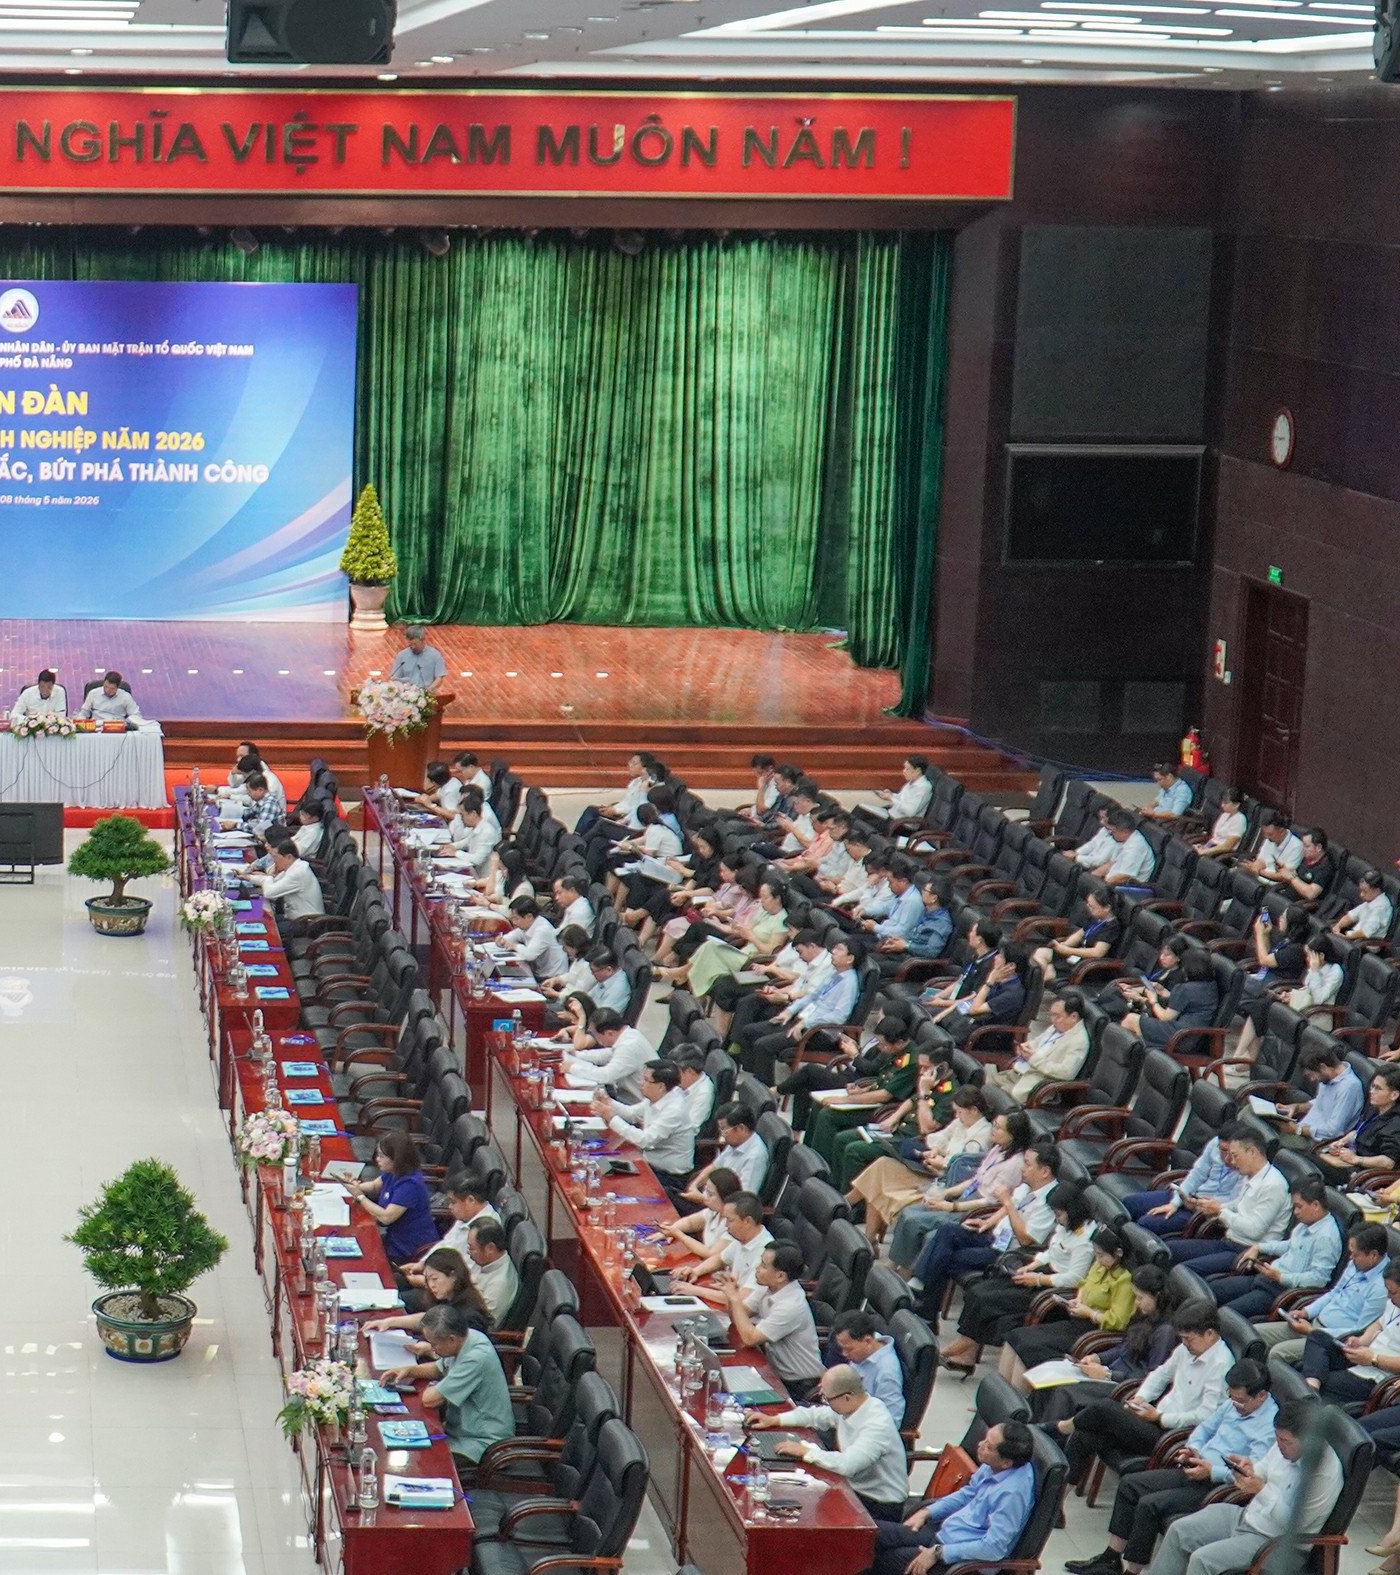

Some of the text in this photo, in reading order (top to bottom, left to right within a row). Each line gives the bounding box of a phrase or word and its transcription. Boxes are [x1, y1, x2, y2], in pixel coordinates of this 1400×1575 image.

[16, 109, 208, 163] NGHĨA
[222, 110, 359, 175] VIỆT
[382, 122, 512, 165] NAM
[536, 113, 718, 168] MUÔN
[743, 117, 875, 169] NĂM
[899, 126, 913, 169] !
[0, 341, 29, 353] NHÂN
[31, 341, 54, 353] DÂN
[62, 340, 76, 354] ỦY
[78, 344, 100, 354] BAN
[102, 341, 124, 356] MẶT
[127, 341, 153, 356] TRẬN
[172, 341, 203, 355] QUỐC
[206, 342, 228, 358] VIỆT
[229, 344, 254, 355] NAM
[0, 354, 21, 368] PHỐ
[23, 356, 39, 368] ĐÀ
[21, 384, 88, 416] ĐÀN
[20, 426, 97, 454] NGHIỆP
[102, 427, 150, 450] NĂM
[155, 432, 205, 451] 2026
[39, 457, 77, 481] BỨT
[81, 457, 124, 482] PHÁ
[129, 459, 199, 483] THÀNH
[204, 459, 270, 484] CÔNG
[0, 495, 13, 504] 08
[14, 495, 42, 507] tháng
[43, 496, 51, 505] 5
[52, 497, 72, 505] năm
[74, 496, 100, 505] 2026
